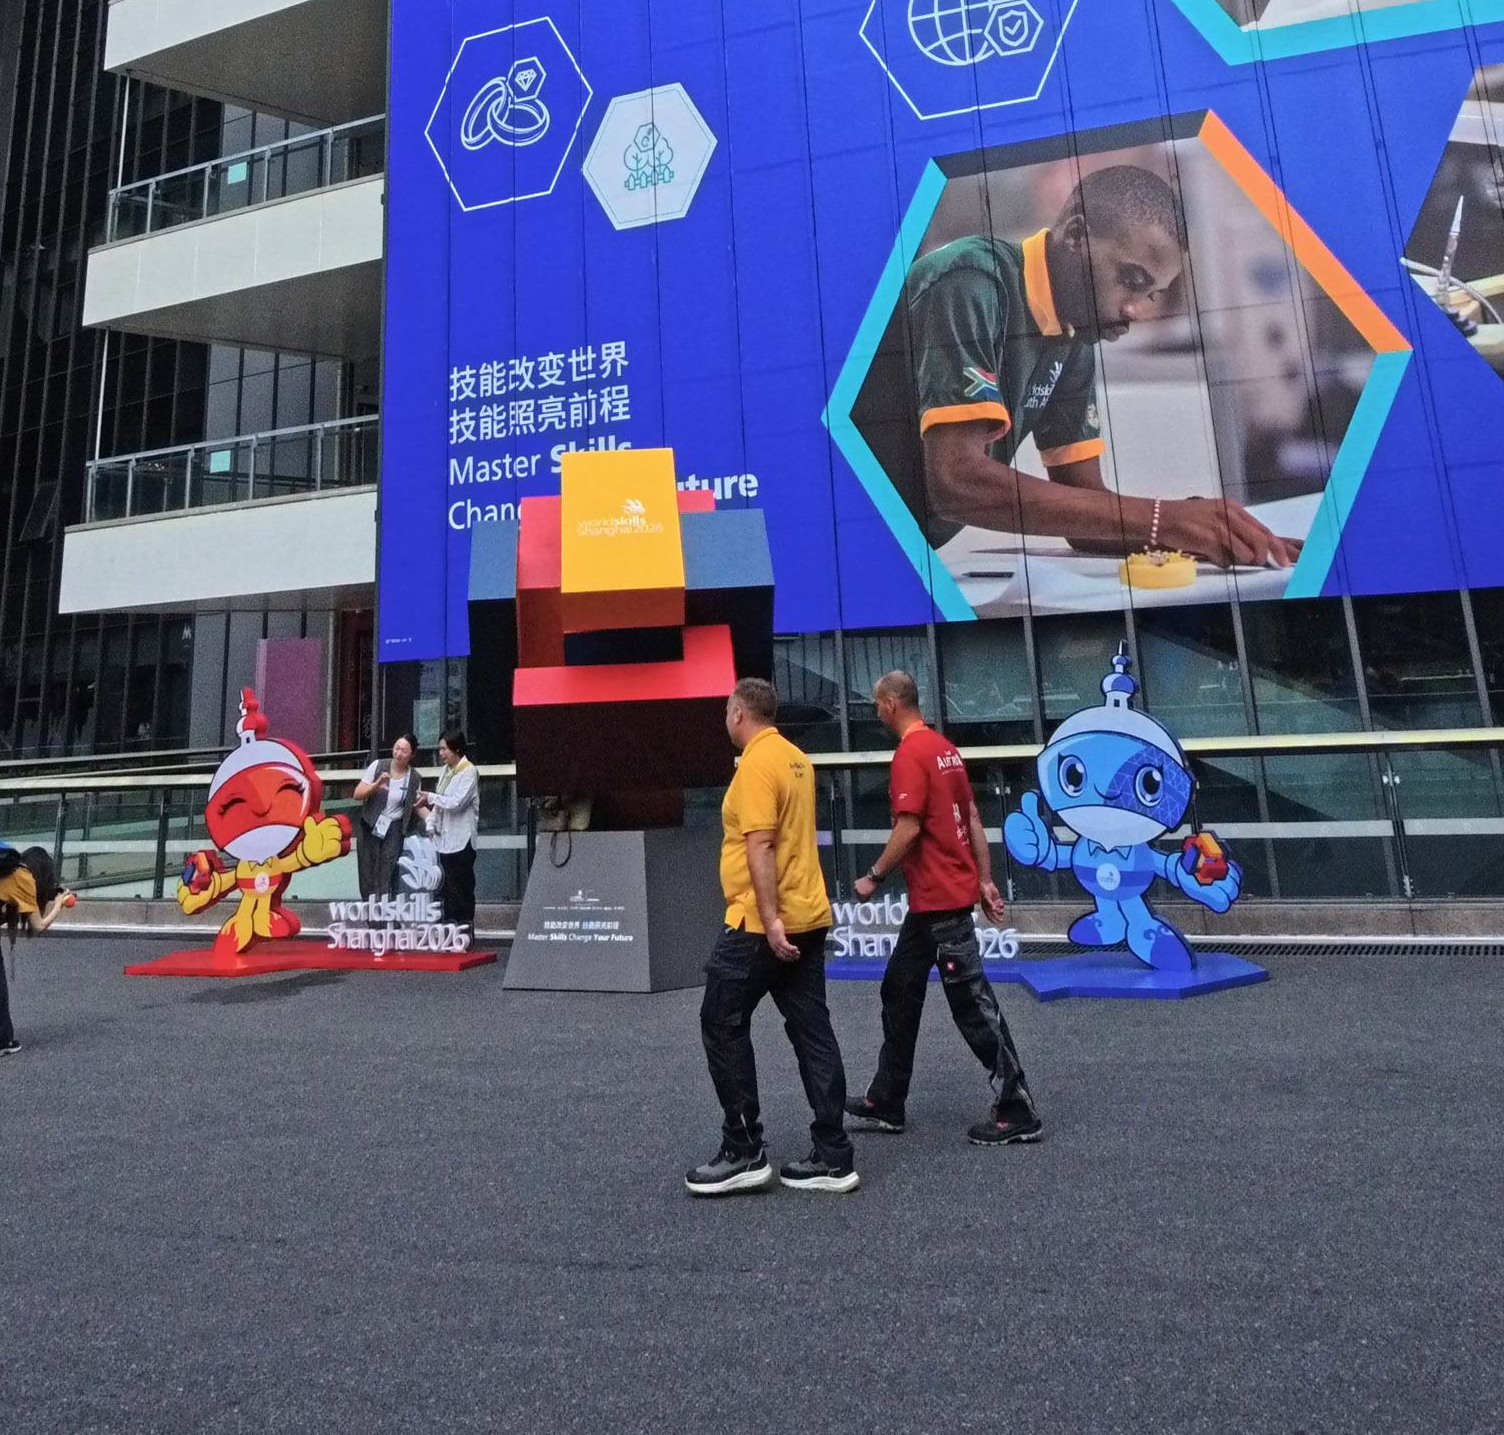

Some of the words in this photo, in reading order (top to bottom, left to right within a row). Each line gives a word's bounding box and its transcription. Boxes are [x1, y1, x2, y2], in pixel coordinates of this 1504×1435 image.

[449, 340, 629, 402] 技能改变世界
[449, 384, 631, 445] 技能照亮前程
[449, 452, 541, 486] Master
[448, 498, 521, 530] Chan
[677, 473, 759, 501] ture
[329, 892, 442, 922] worldskills
[327, 921, 418, 956] Shanghai
[417, 923, 470, 953] 2026
[833, 925, 899, 957] Shan
[975, 927, 1019, 959] 26
